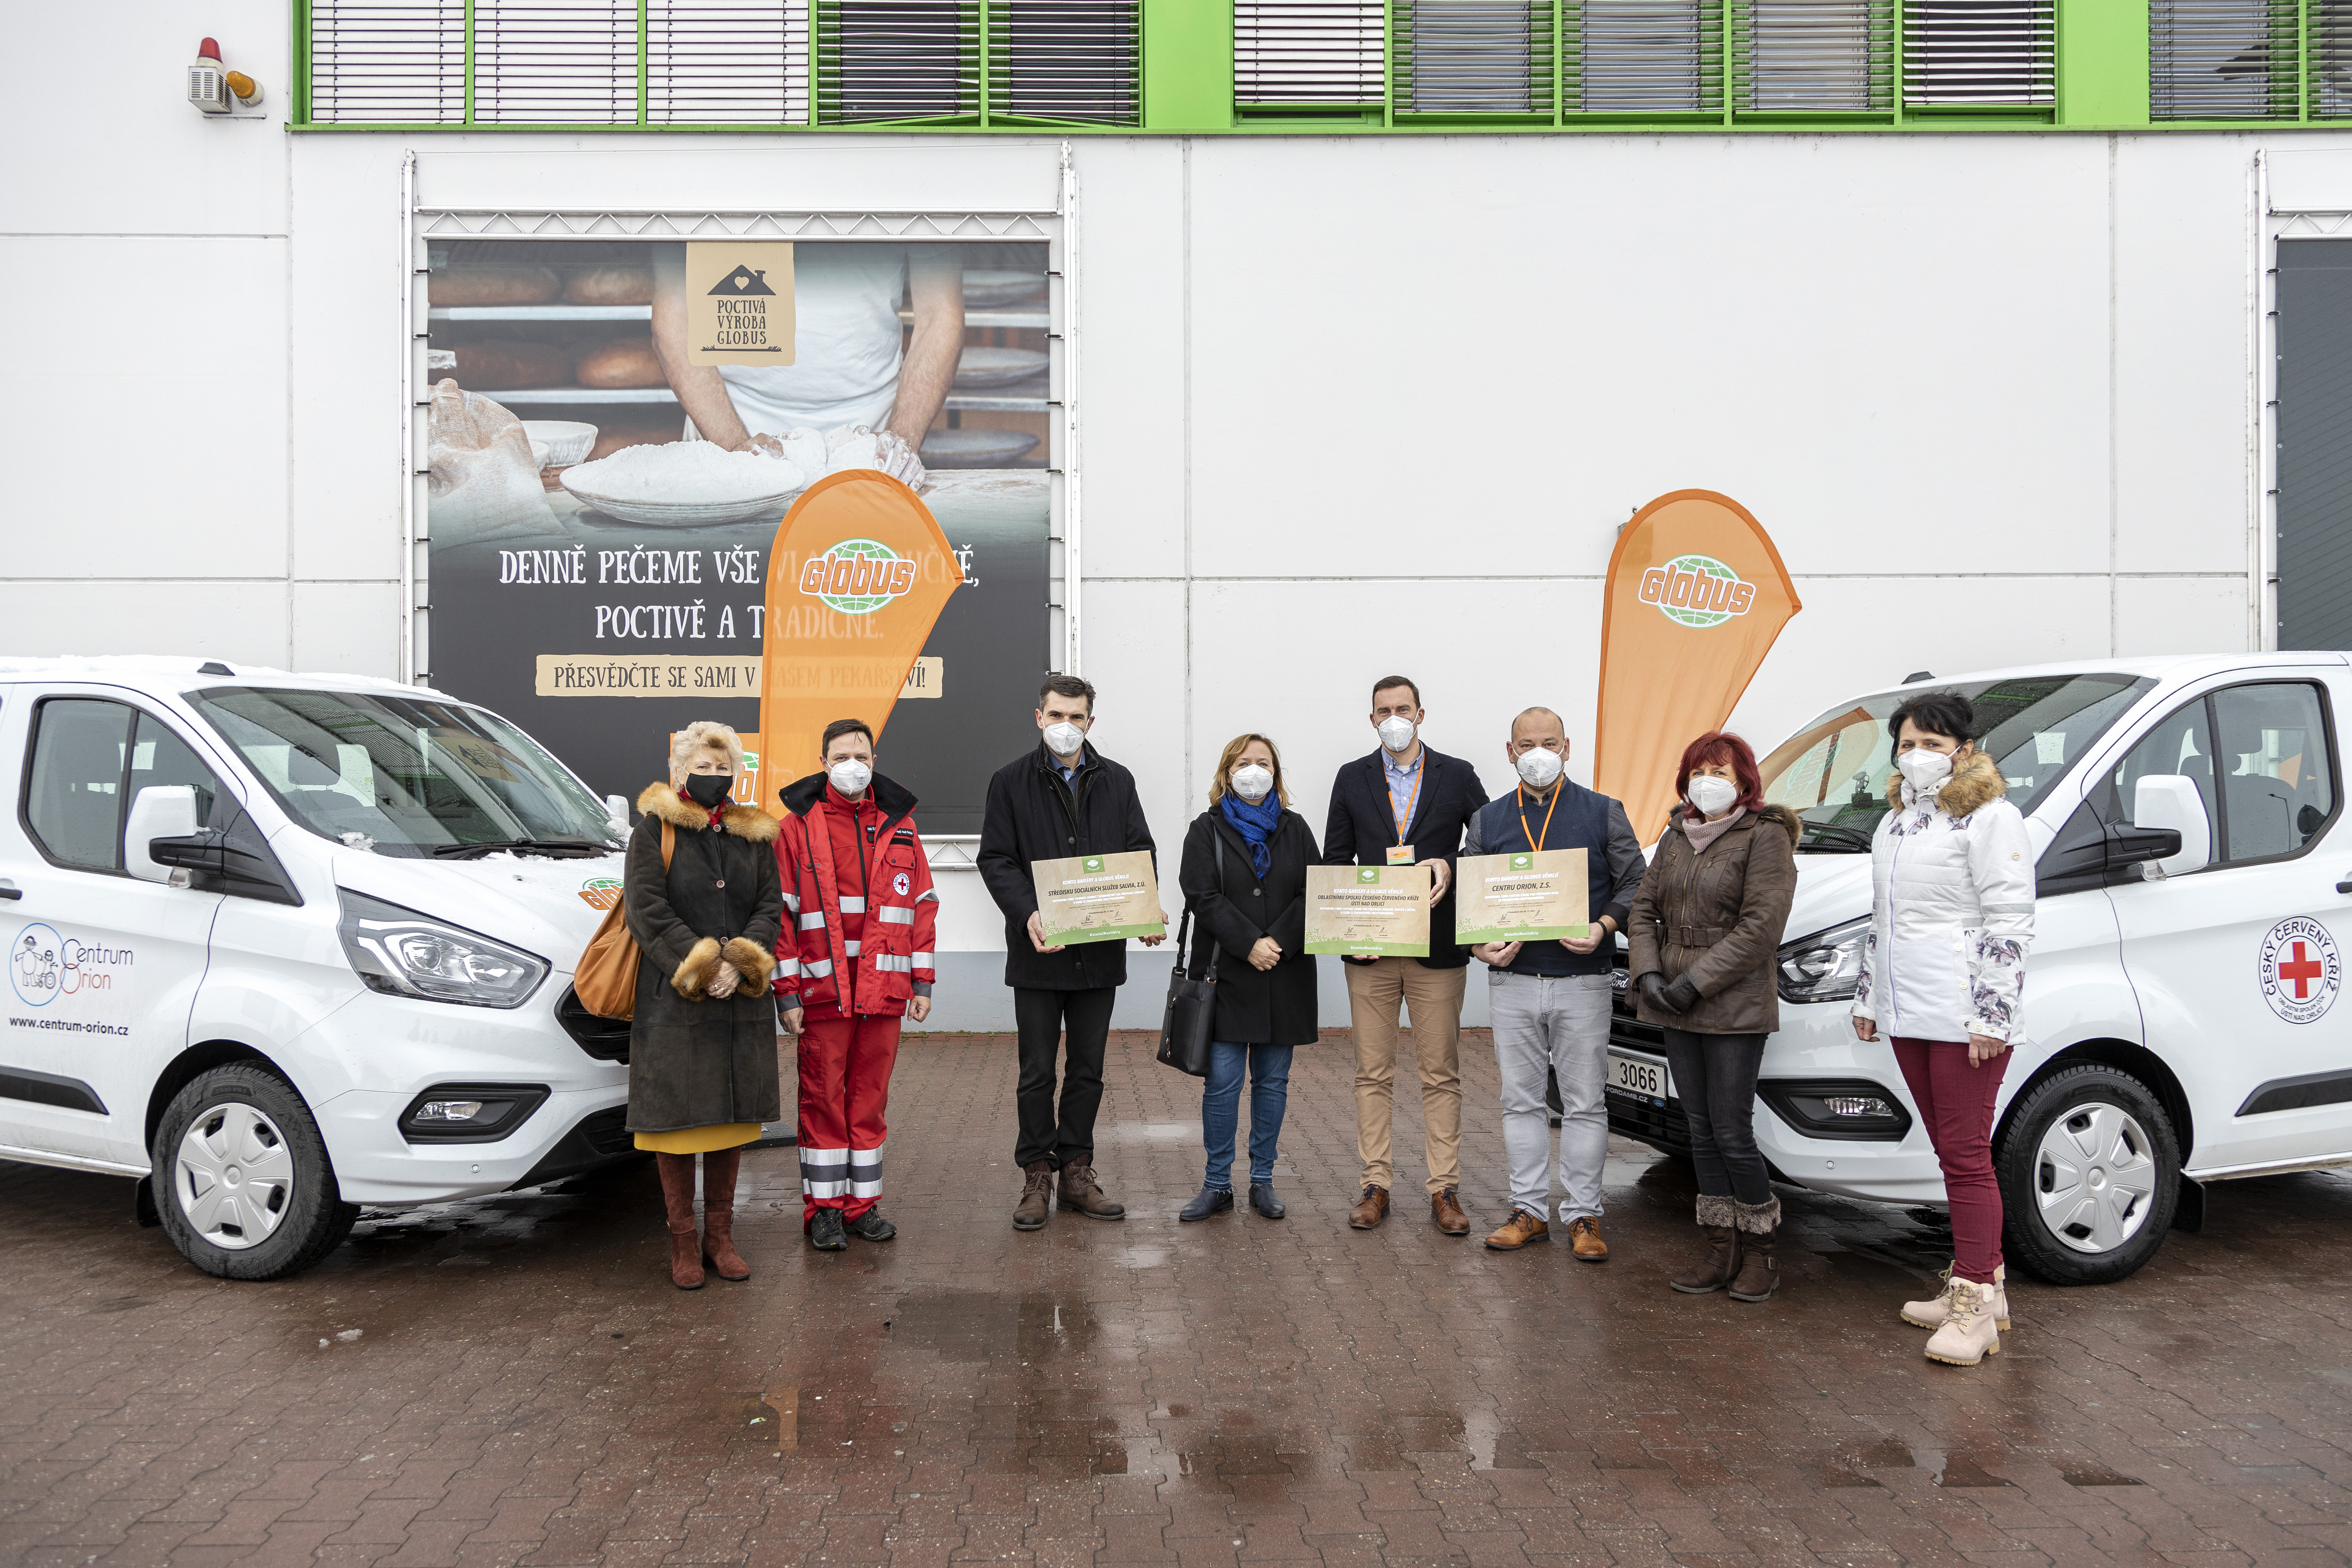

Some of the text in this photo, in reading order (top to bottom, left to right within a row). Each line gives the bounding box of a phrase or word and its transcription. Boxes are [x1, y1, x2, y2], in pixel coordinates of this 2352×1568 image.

[717, 298, 766, 313] POCTIVÁ
[717, 313, 766, 329] VÝROBA
[717, 331, 766, 344] GLOBUS
[499, 544, 586, 584] DENNĚ
[598, 544, 702, 584] PEČEME
[714, 544, 759, 584] VŠE
[595, 599, 705, 638] POCTIVĚ
[717, 605, 736, 638] A
[554, 663, 660, 688] PŘESVĚDČTE
[668, 667, 687, 688] SE
[694, 667, 736, 688] SAMI
[745, 667, 755, 687] V
[2274, 921, 2331, 948] ČERVENÝ
[61, 939, 133, 969] Centrum
[60, 963, 111, 994] Orion
[1610, 972, 1629, 988] Ford
[2263, 940, 2276, 996] ČESKÝ
[2325, 952, 2340, 992] KŘÍŽ
[2278, 997, 2299, 1013] OBLASTNÍ
[2299, 1002, 2317, 1013] SPOLEK
[2281, 1007, 2293, 1019] ÚSTÍ
[2306, 1005, 2324, 1019] ORLICÍ
[9, 1017, 129, 1036] www.centrum-orion.cz
[1620, 1061, 1657, 1092] 3066
[1603, 1086, 1648, 1103] .FORDAMB.CZ
